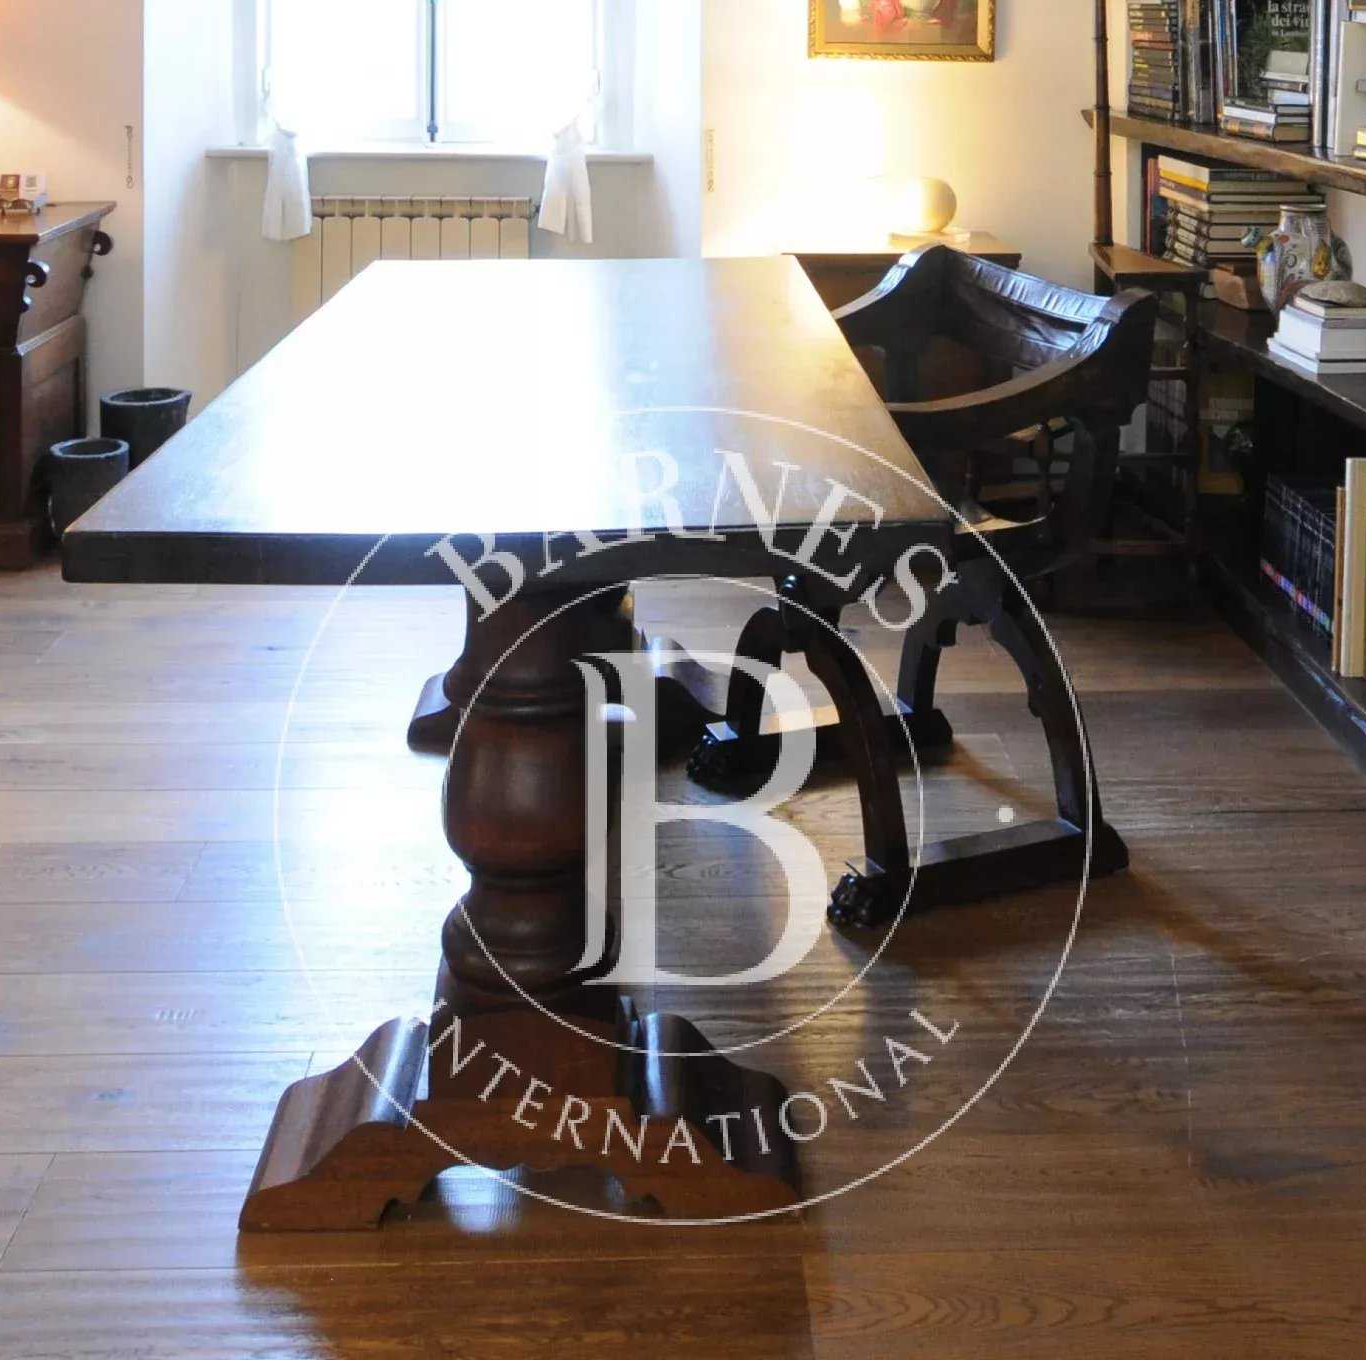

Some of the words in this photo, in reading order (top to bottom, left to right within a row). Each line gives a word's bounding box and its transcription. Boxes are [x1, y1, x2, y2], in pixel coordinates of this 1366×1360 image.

[1267, 0, 1279, 14] la
[1281, 0, 1312, 14] stra
[1271, 14, 1290, 28] dei
